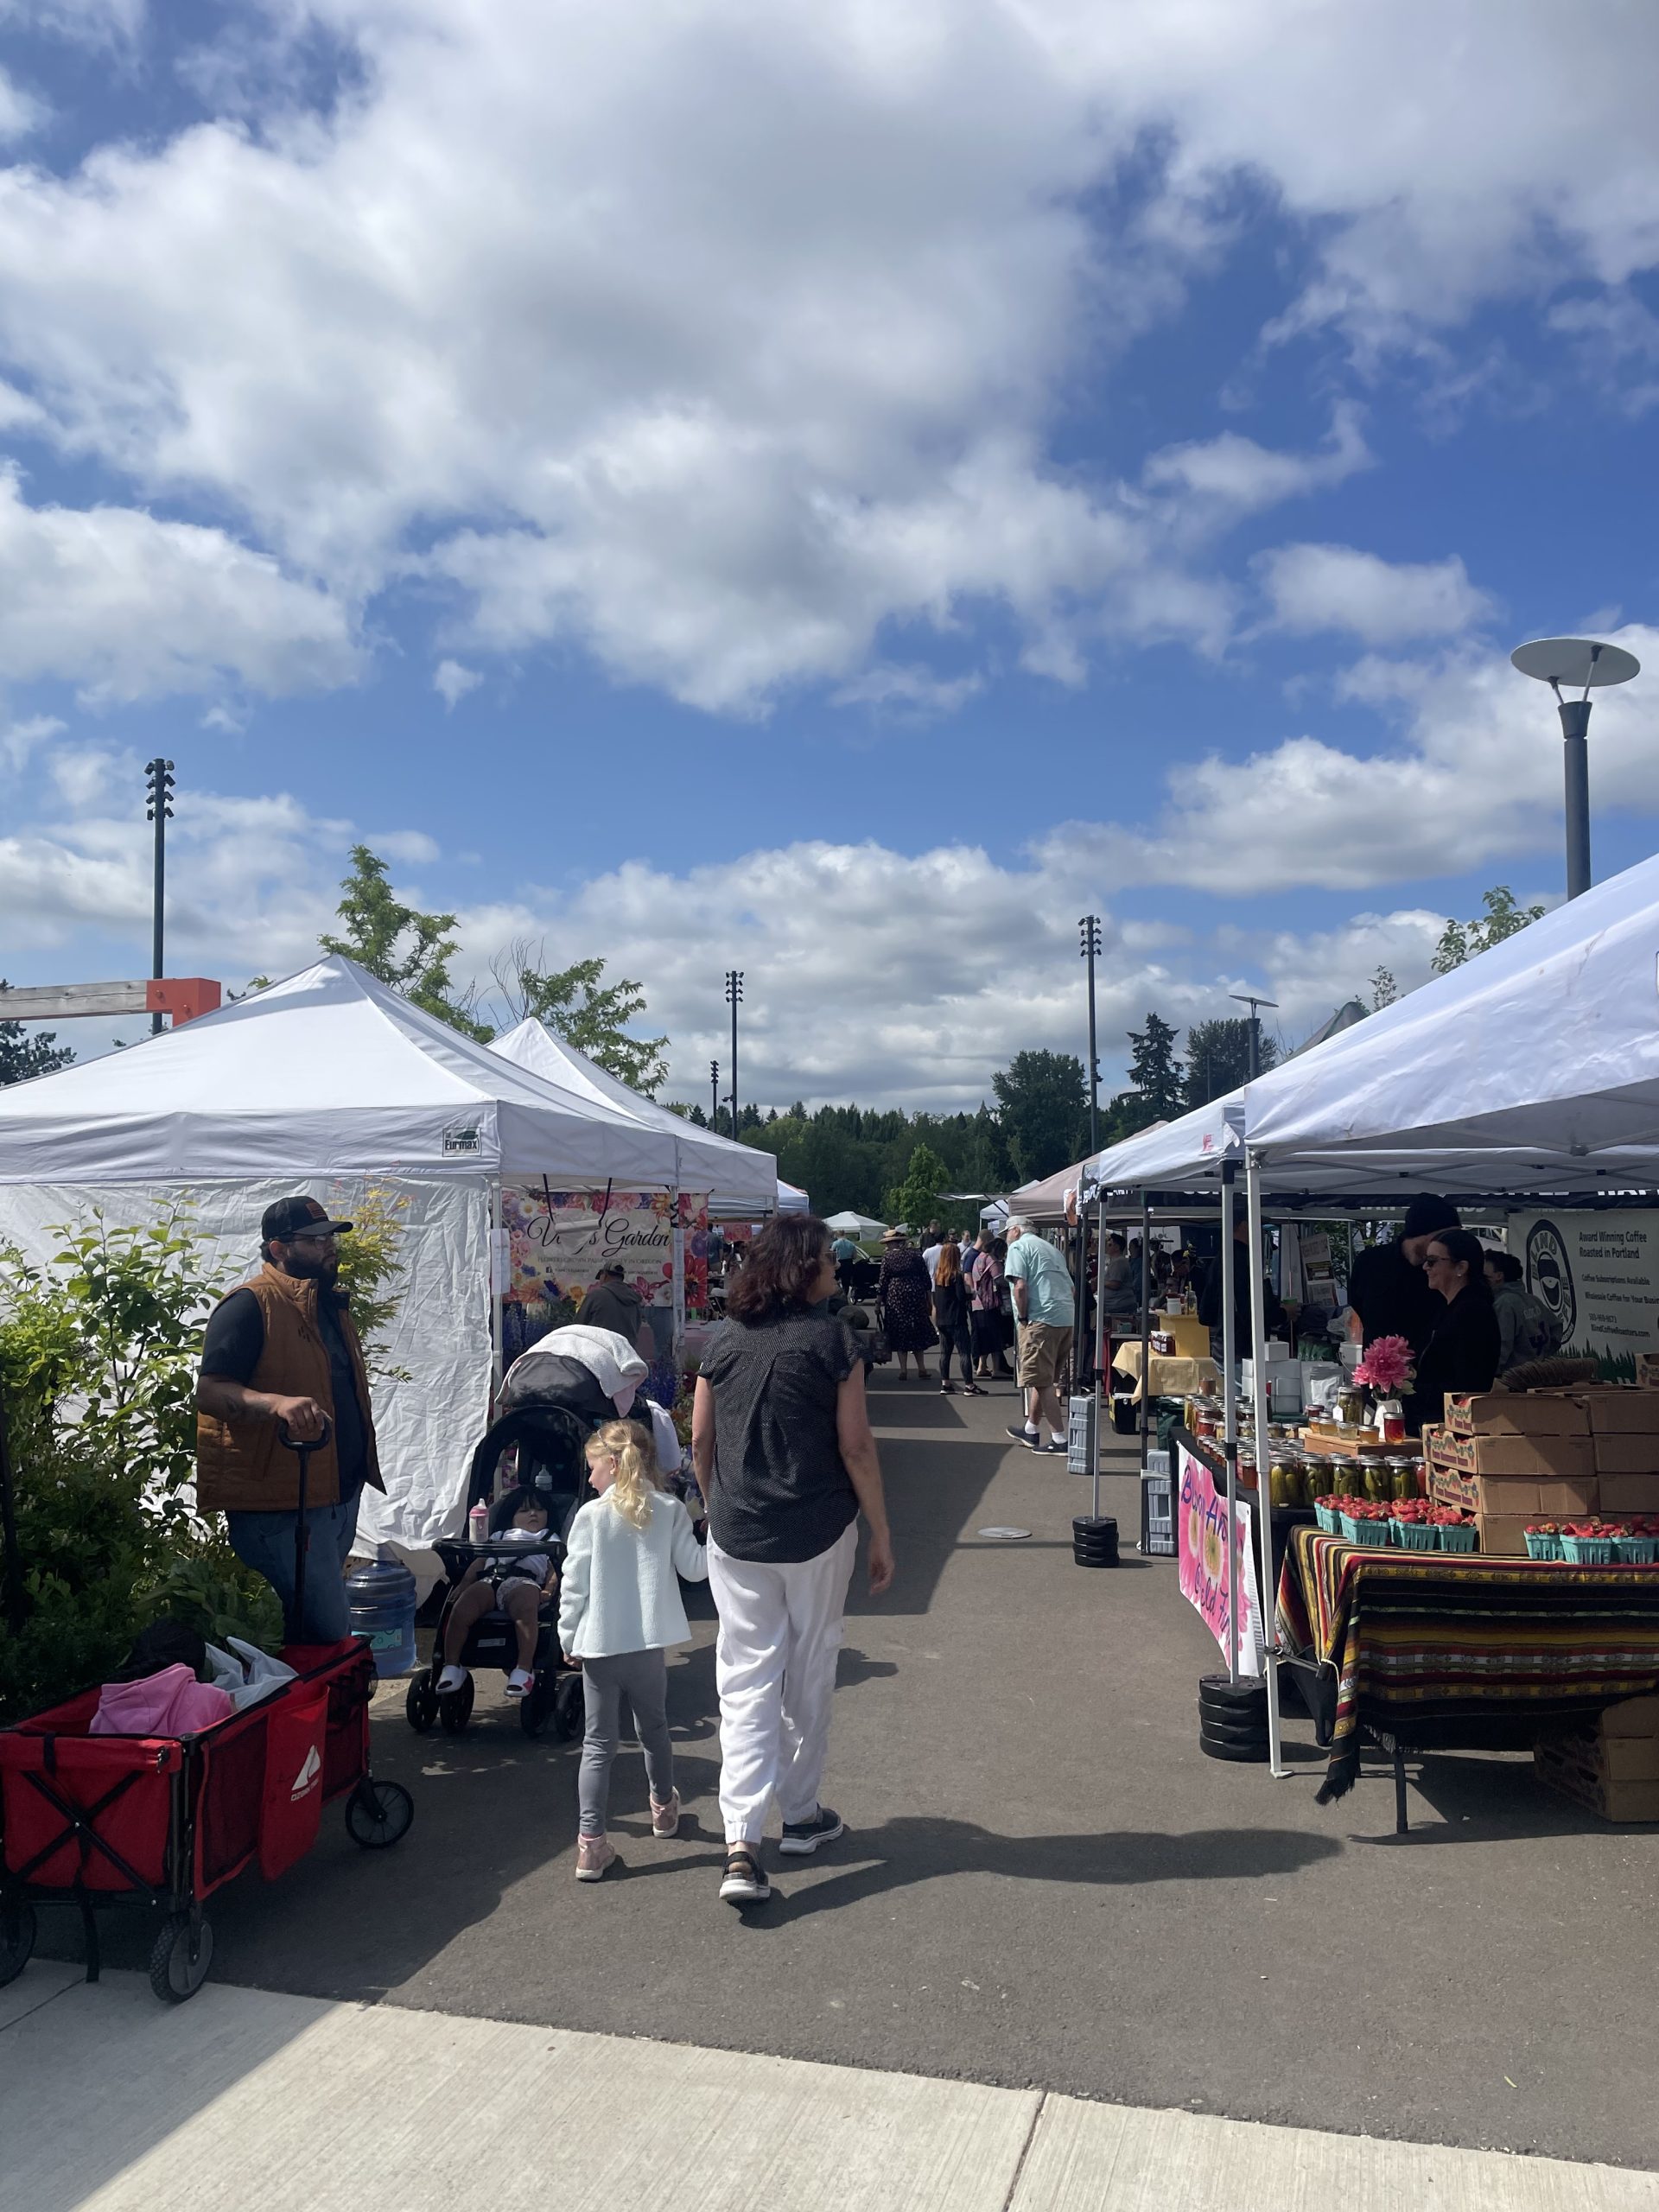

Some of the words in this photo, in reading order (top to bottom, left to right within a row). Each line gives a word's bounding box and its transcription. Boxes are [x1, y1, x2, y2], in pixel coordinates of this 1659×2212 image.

[445, 1140, 478, 1151] Eurmax
[601, 1217, 671, 1257] Garden
[1580, 1231, 1598, 1243] Award
[1599, 1230, 1624, 1245] Winning
[1625, 1230, 1648, 1243] Coffee
[1580, 1247, 1603, 1258] Roasted
[1605, 1247, 1611, 1258] in
[1611, 1247, 1640, 1259] Portland
